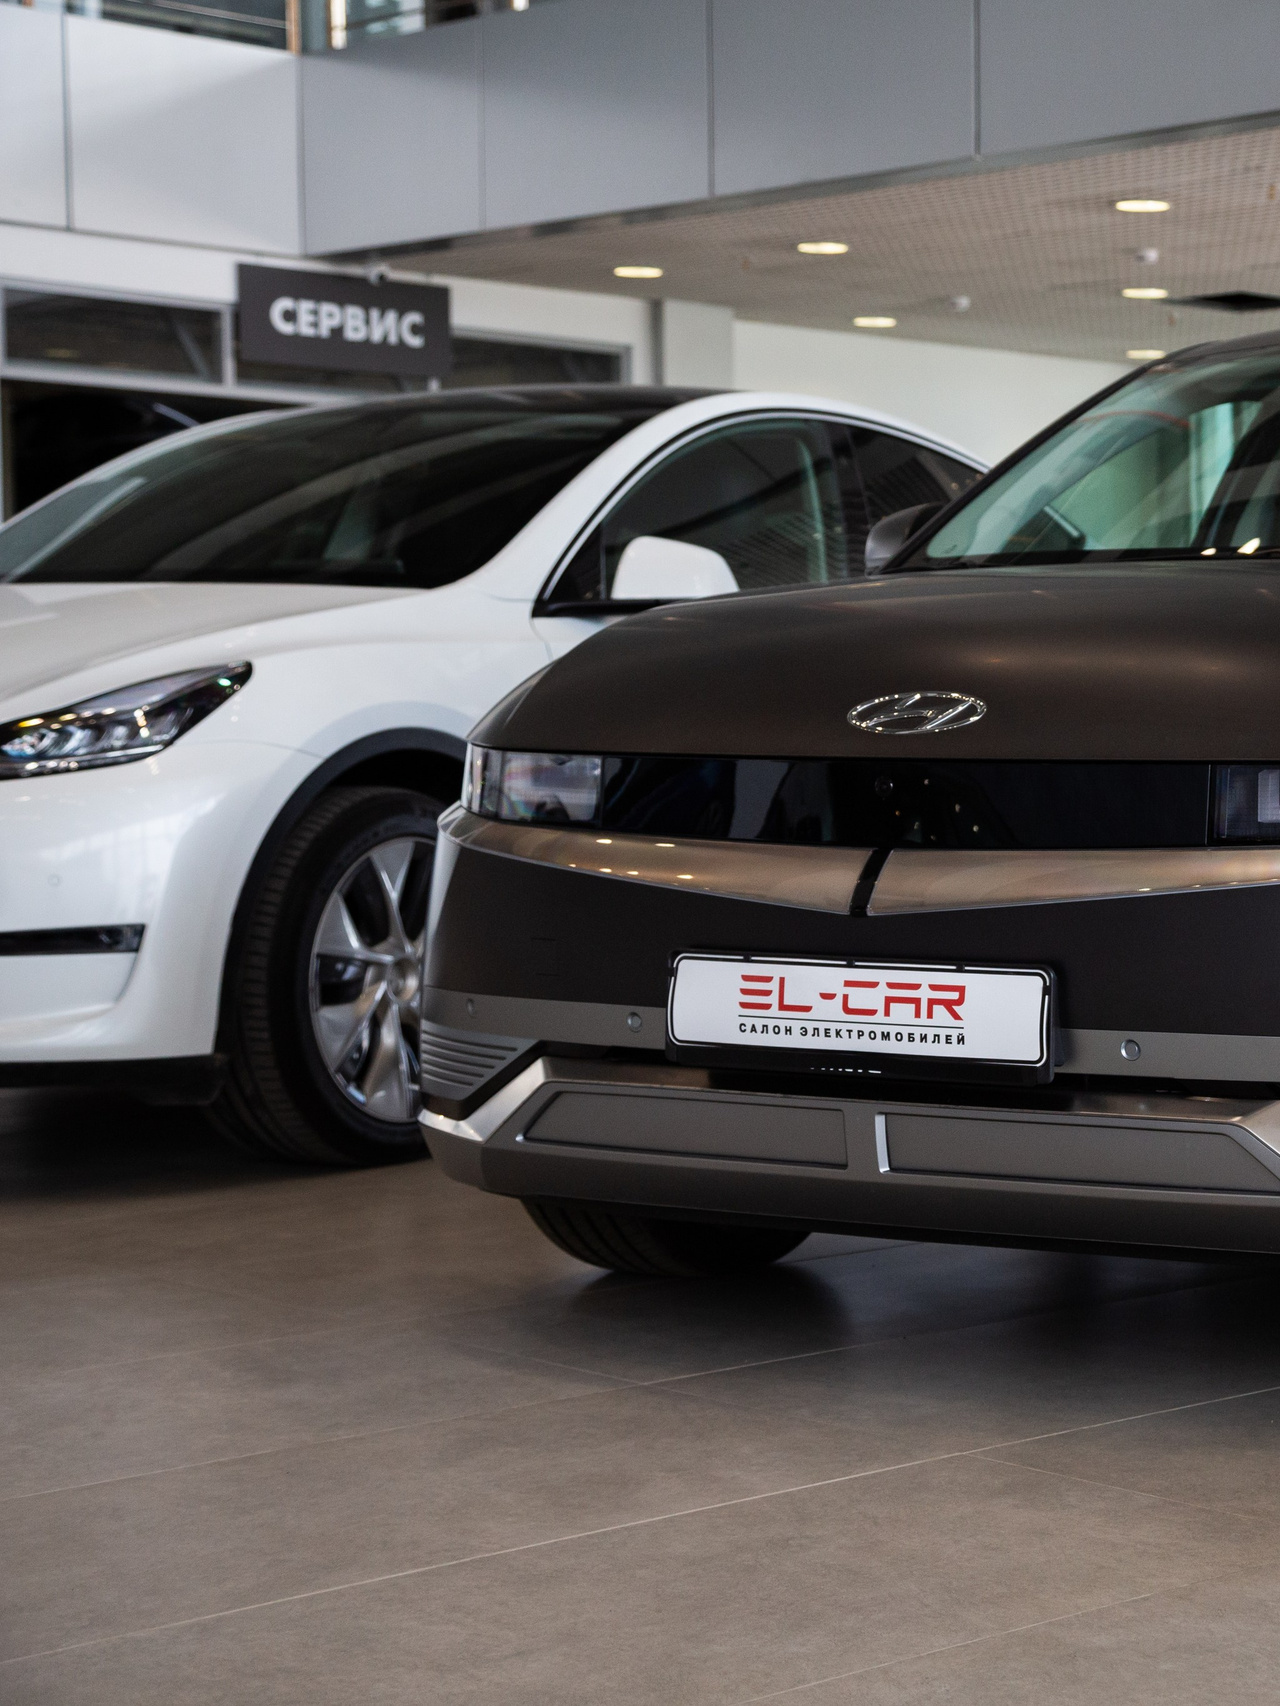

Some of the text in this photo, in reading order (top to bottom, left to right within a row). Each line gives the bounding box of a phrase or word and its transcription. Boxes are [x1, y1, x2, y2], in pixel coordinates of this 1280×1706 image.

[269, 296, 425, 349] СЕРВИС
[738, 974, 966, 1021] EL-CAR
[738, 1023, 966, 1046] САЛОН ЭЛЕКТРОМОБИЛЕЙ
